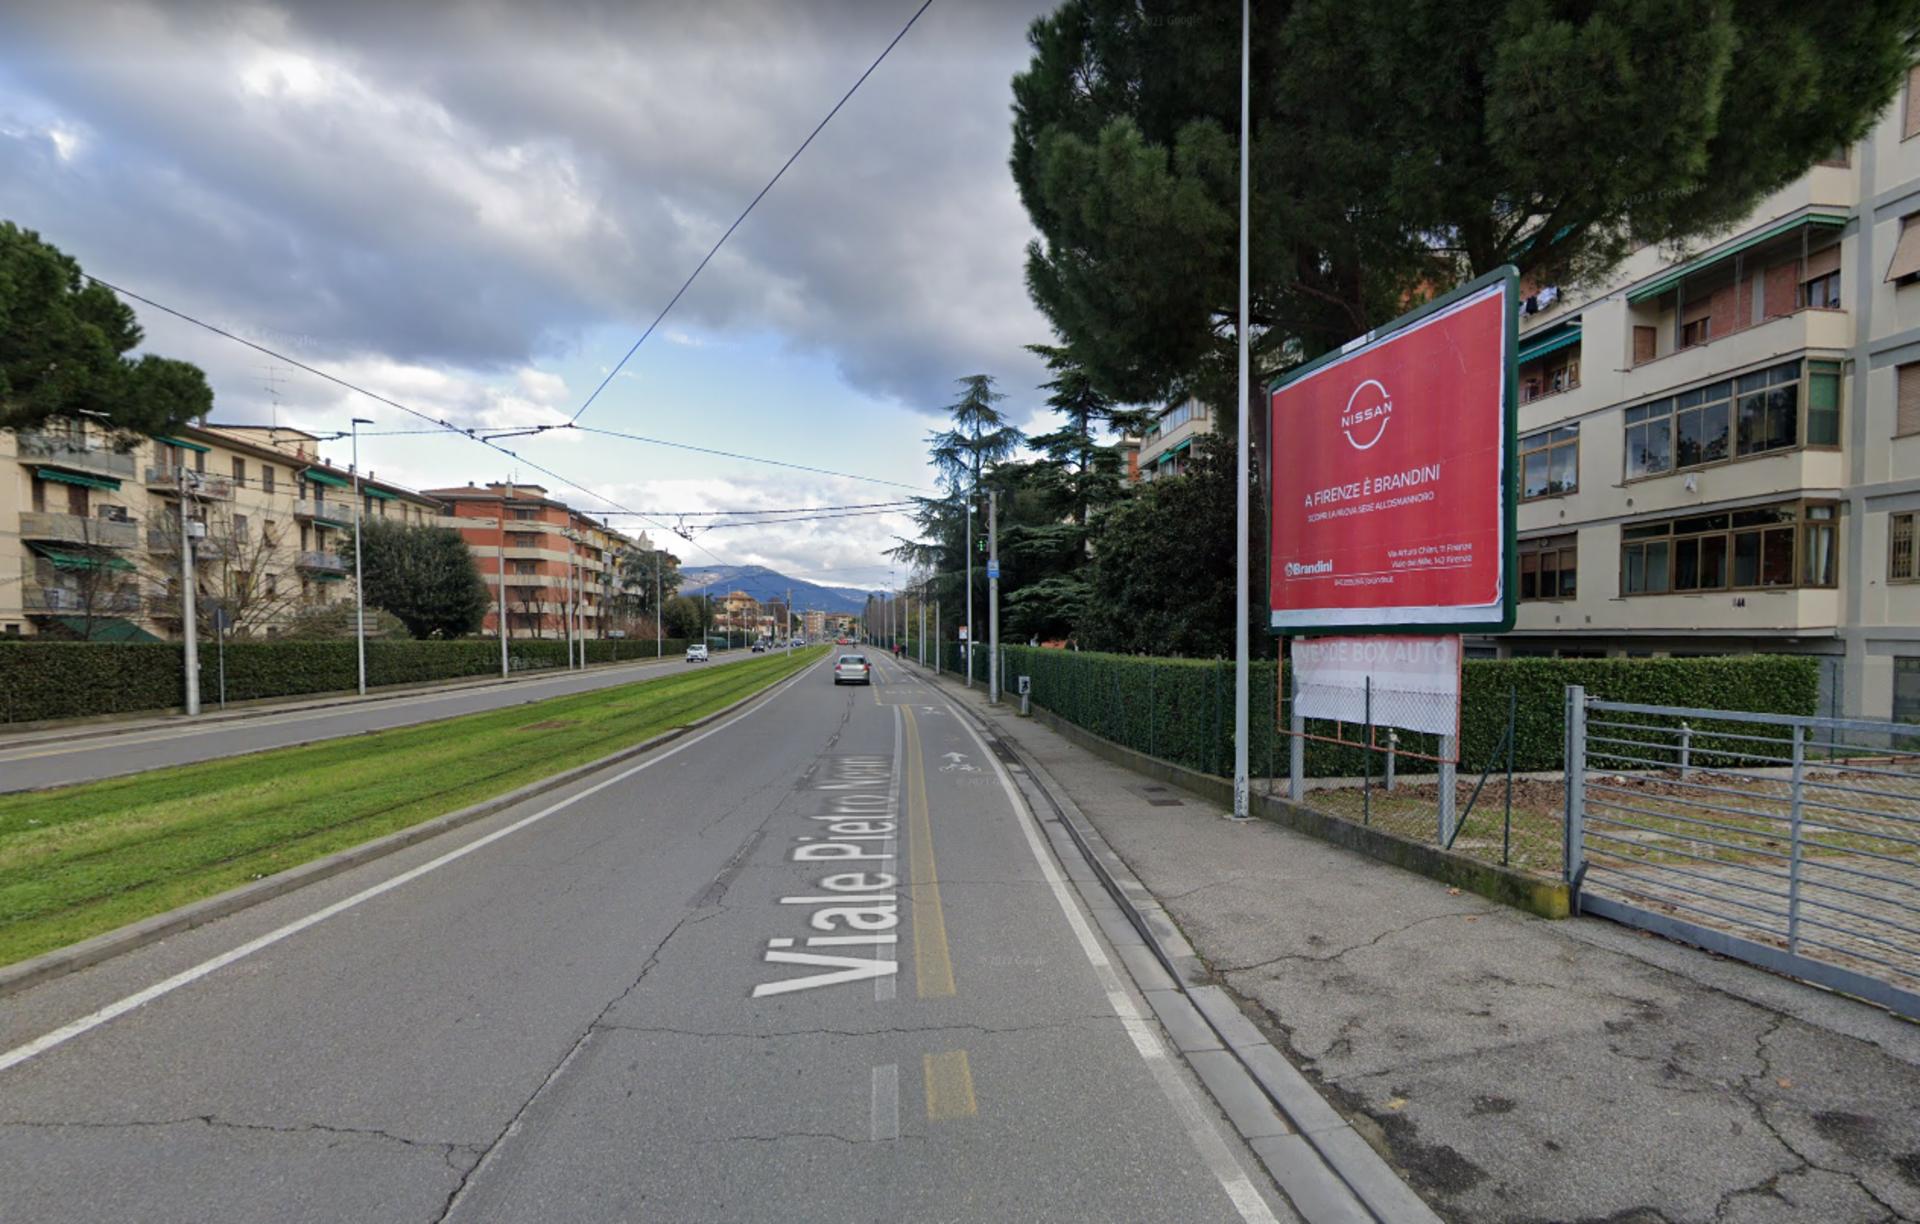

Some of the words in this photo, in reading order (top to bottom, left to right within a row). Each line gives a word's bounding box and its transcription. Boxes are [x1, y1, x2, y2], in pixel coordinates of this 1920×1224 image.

[1342, 400, 1391, 428] NISSAN
[1305, 494, 1313, 508] A
[1314, 483, 1360, 506] FIRENZE
[1363, 477, 1371, 496] È
[1374, 463, 1440, 493] BRANDINI
[1446, 542, 1473, 552] Firenze
[1293, 559, 1333, 576] Brandini
[1446, 554, 1473, 564] Firenze
[1353, 641, 1390, 665] BOX
[1393, 641, 1449, 666] AUTO
